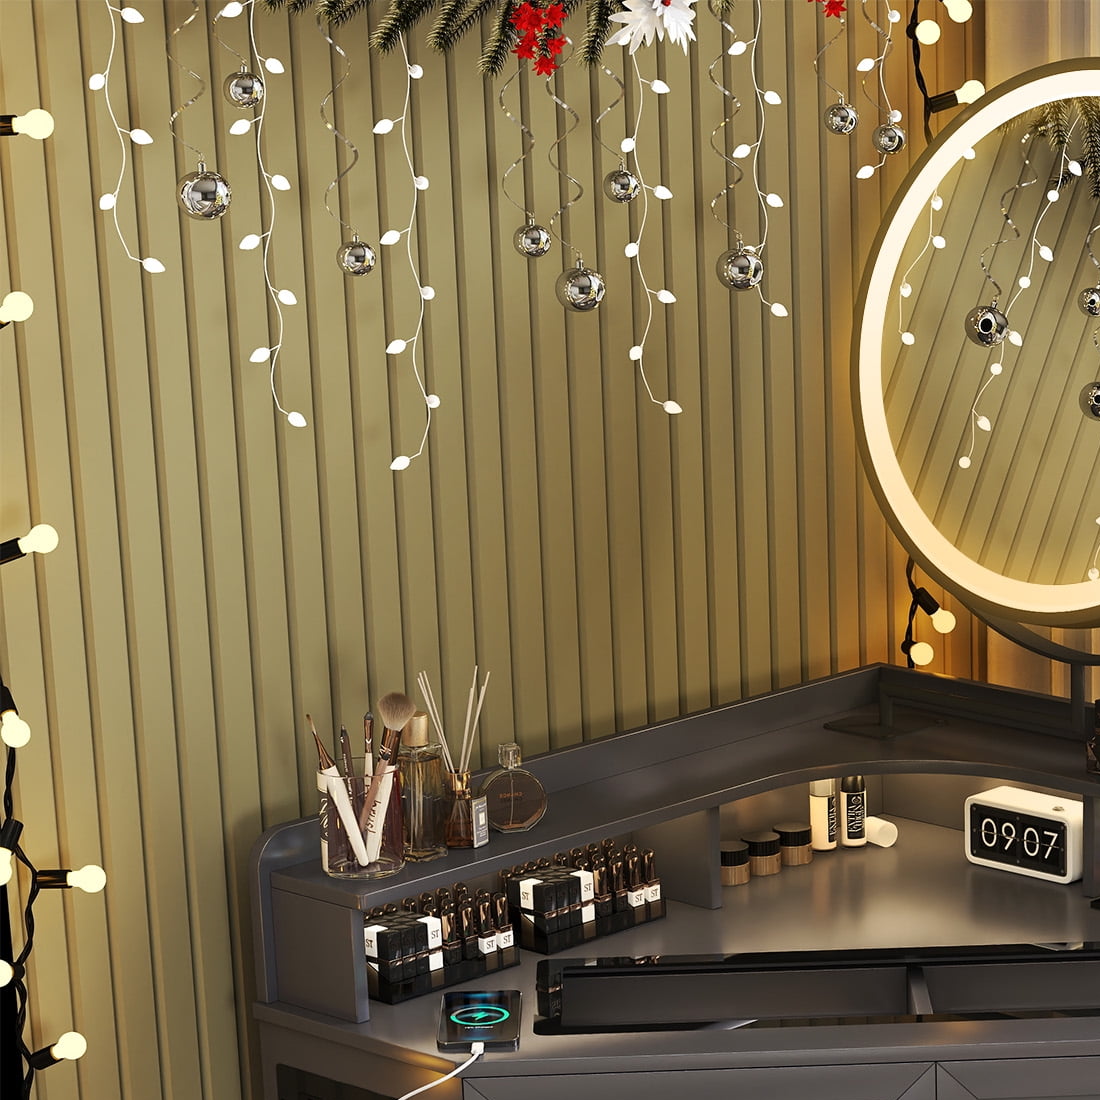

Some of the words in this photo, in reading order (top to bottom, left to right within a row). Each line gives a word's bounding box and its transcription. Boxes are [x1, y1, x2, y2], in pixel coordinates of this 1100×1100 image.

[584, 883, 592, 892] ST
[522, 892, 529, 901] ST
[650, 888, 659, 897] ST
[635, 894, 643, 903] ST
[431, 930, 439, 940] ST
[503, 935, 511, 944] ST
[366, 939, 374, 949] ST
[487, 940, 495, 949] ST
